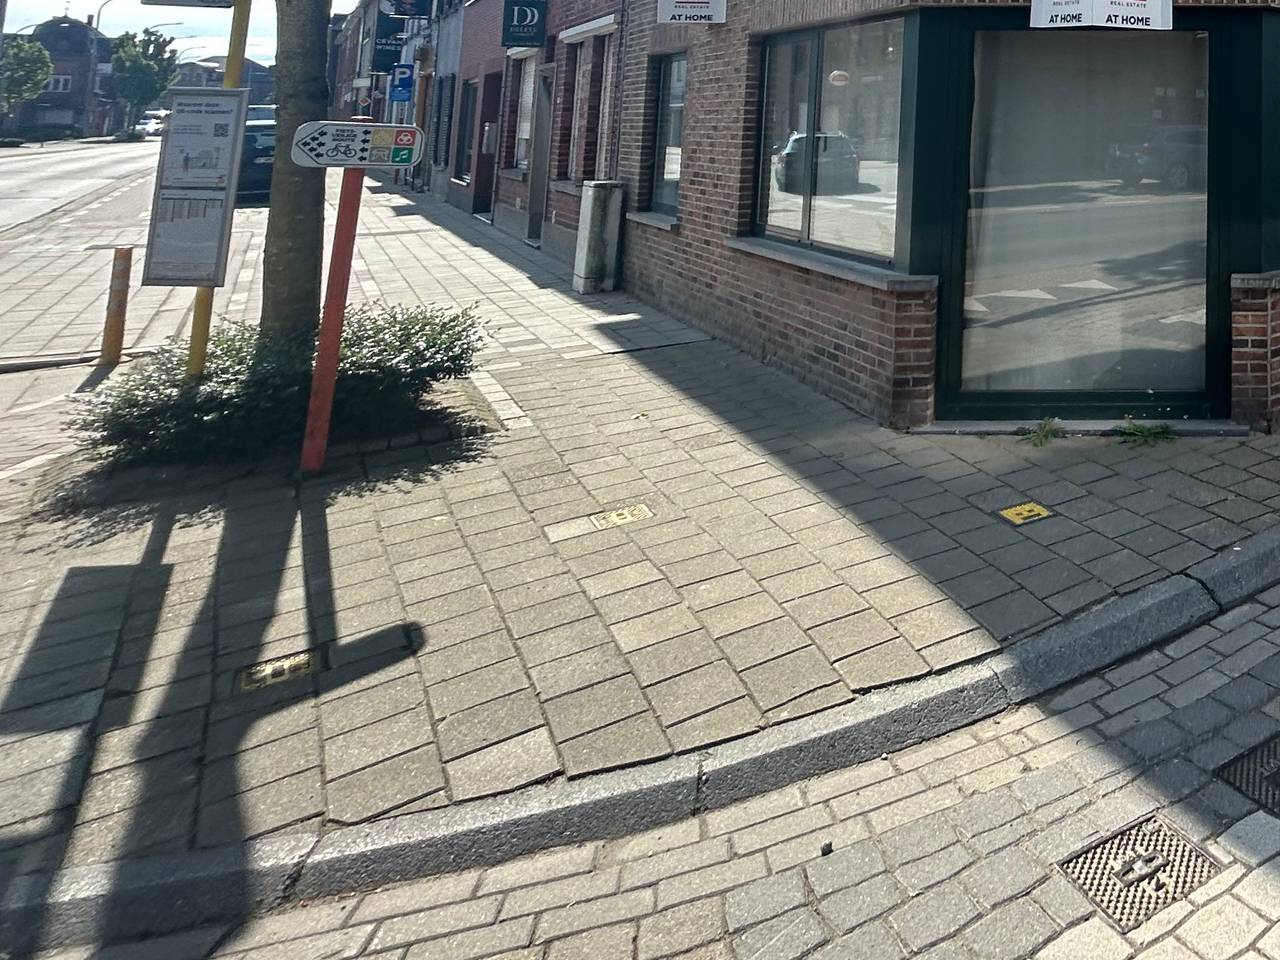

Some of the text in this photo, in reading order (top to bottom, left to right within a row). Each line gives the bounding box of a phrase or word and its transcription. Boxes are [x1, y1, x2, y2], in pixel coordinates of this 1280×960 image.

[1110, 0, 1147, 9] REAL ESTATE
[684, 14, 713, 22] HOME
[1049, 13, 1083, 24] AT HOME
[1105, 13, 1151, 26] AT HOME
[393, 68, 411, 85] P
